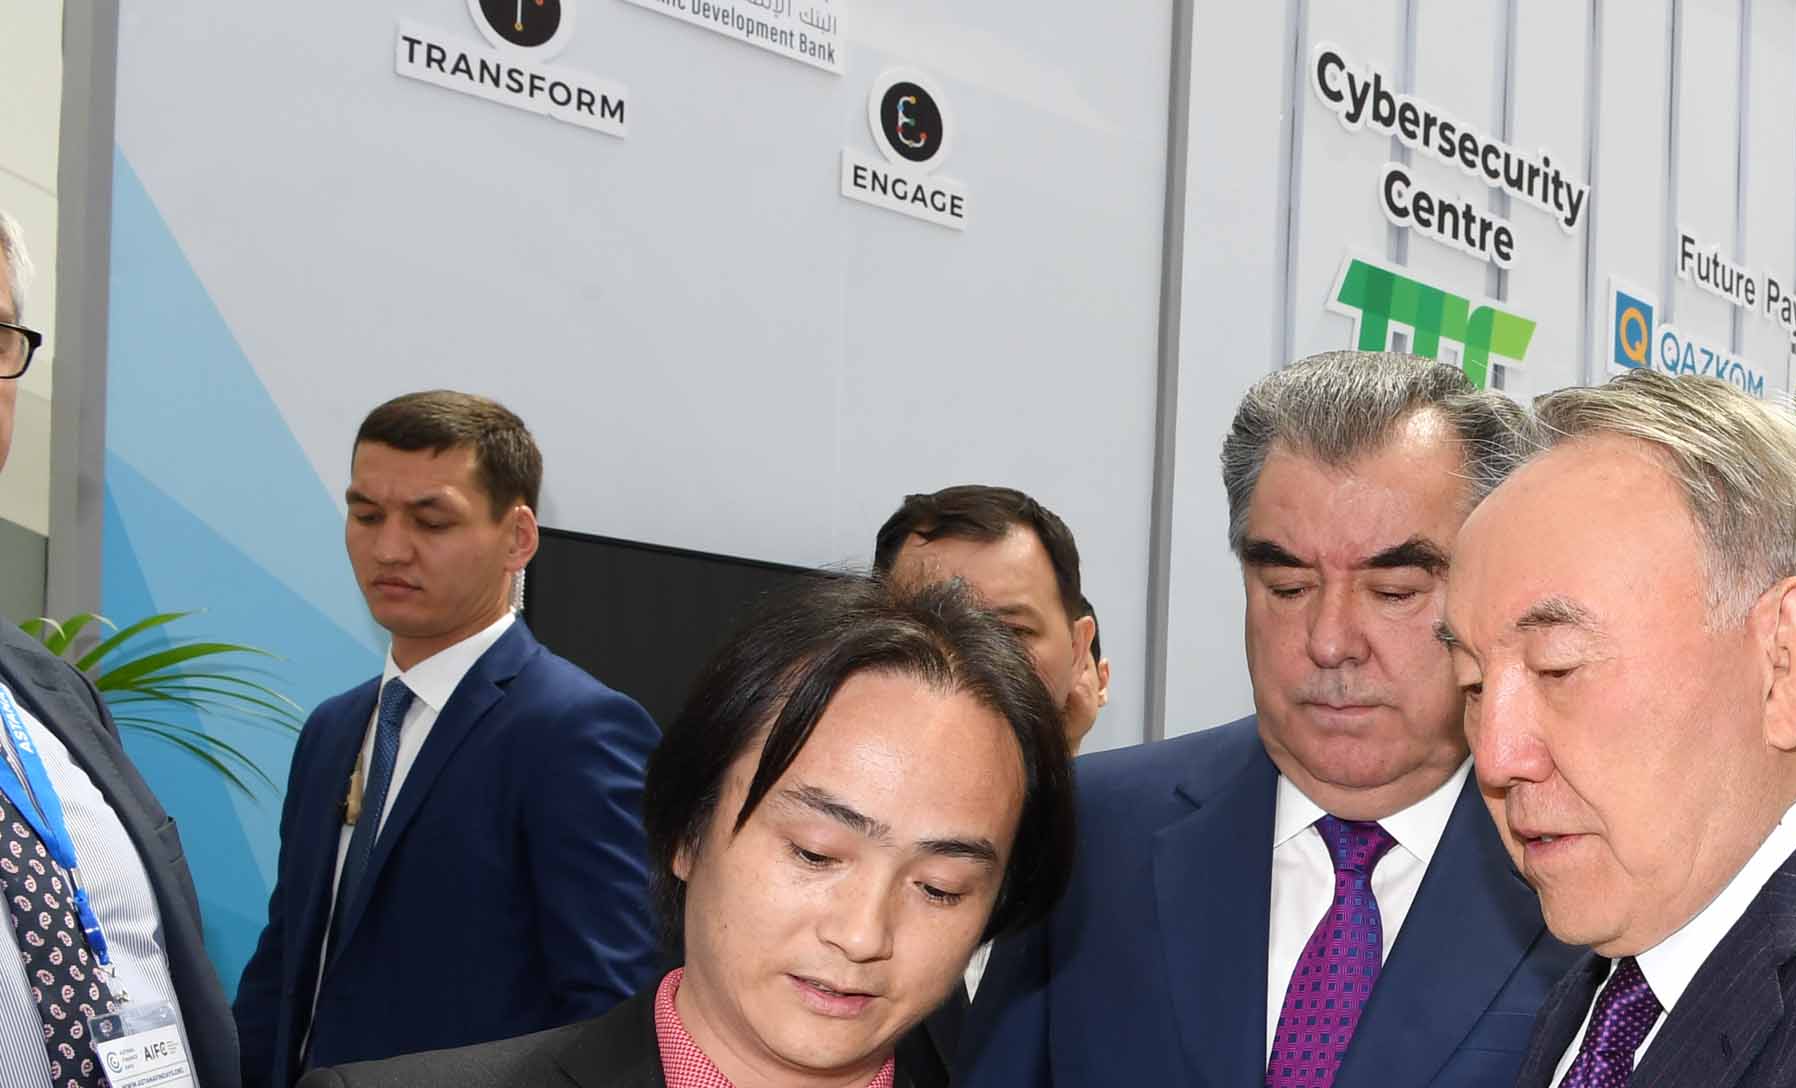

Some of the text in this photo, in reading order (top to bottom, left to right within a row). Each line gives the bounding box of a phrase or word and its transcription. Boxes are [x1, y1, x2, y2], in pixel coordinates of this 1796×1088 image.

[691, 0, 795, 49] Development
[799, 33, 836, 64] Bank
[402, 35, 625, 123] TRANSFORM
[1317, 51, 1584, 227] Cybersecurity
[853, 164, 965, 218] ENGAGE
[1384, 169, 1514, 262] Centre
[1681, 234, 1756, 305] Future
[144, 1041, 168, 1062] AIFC
